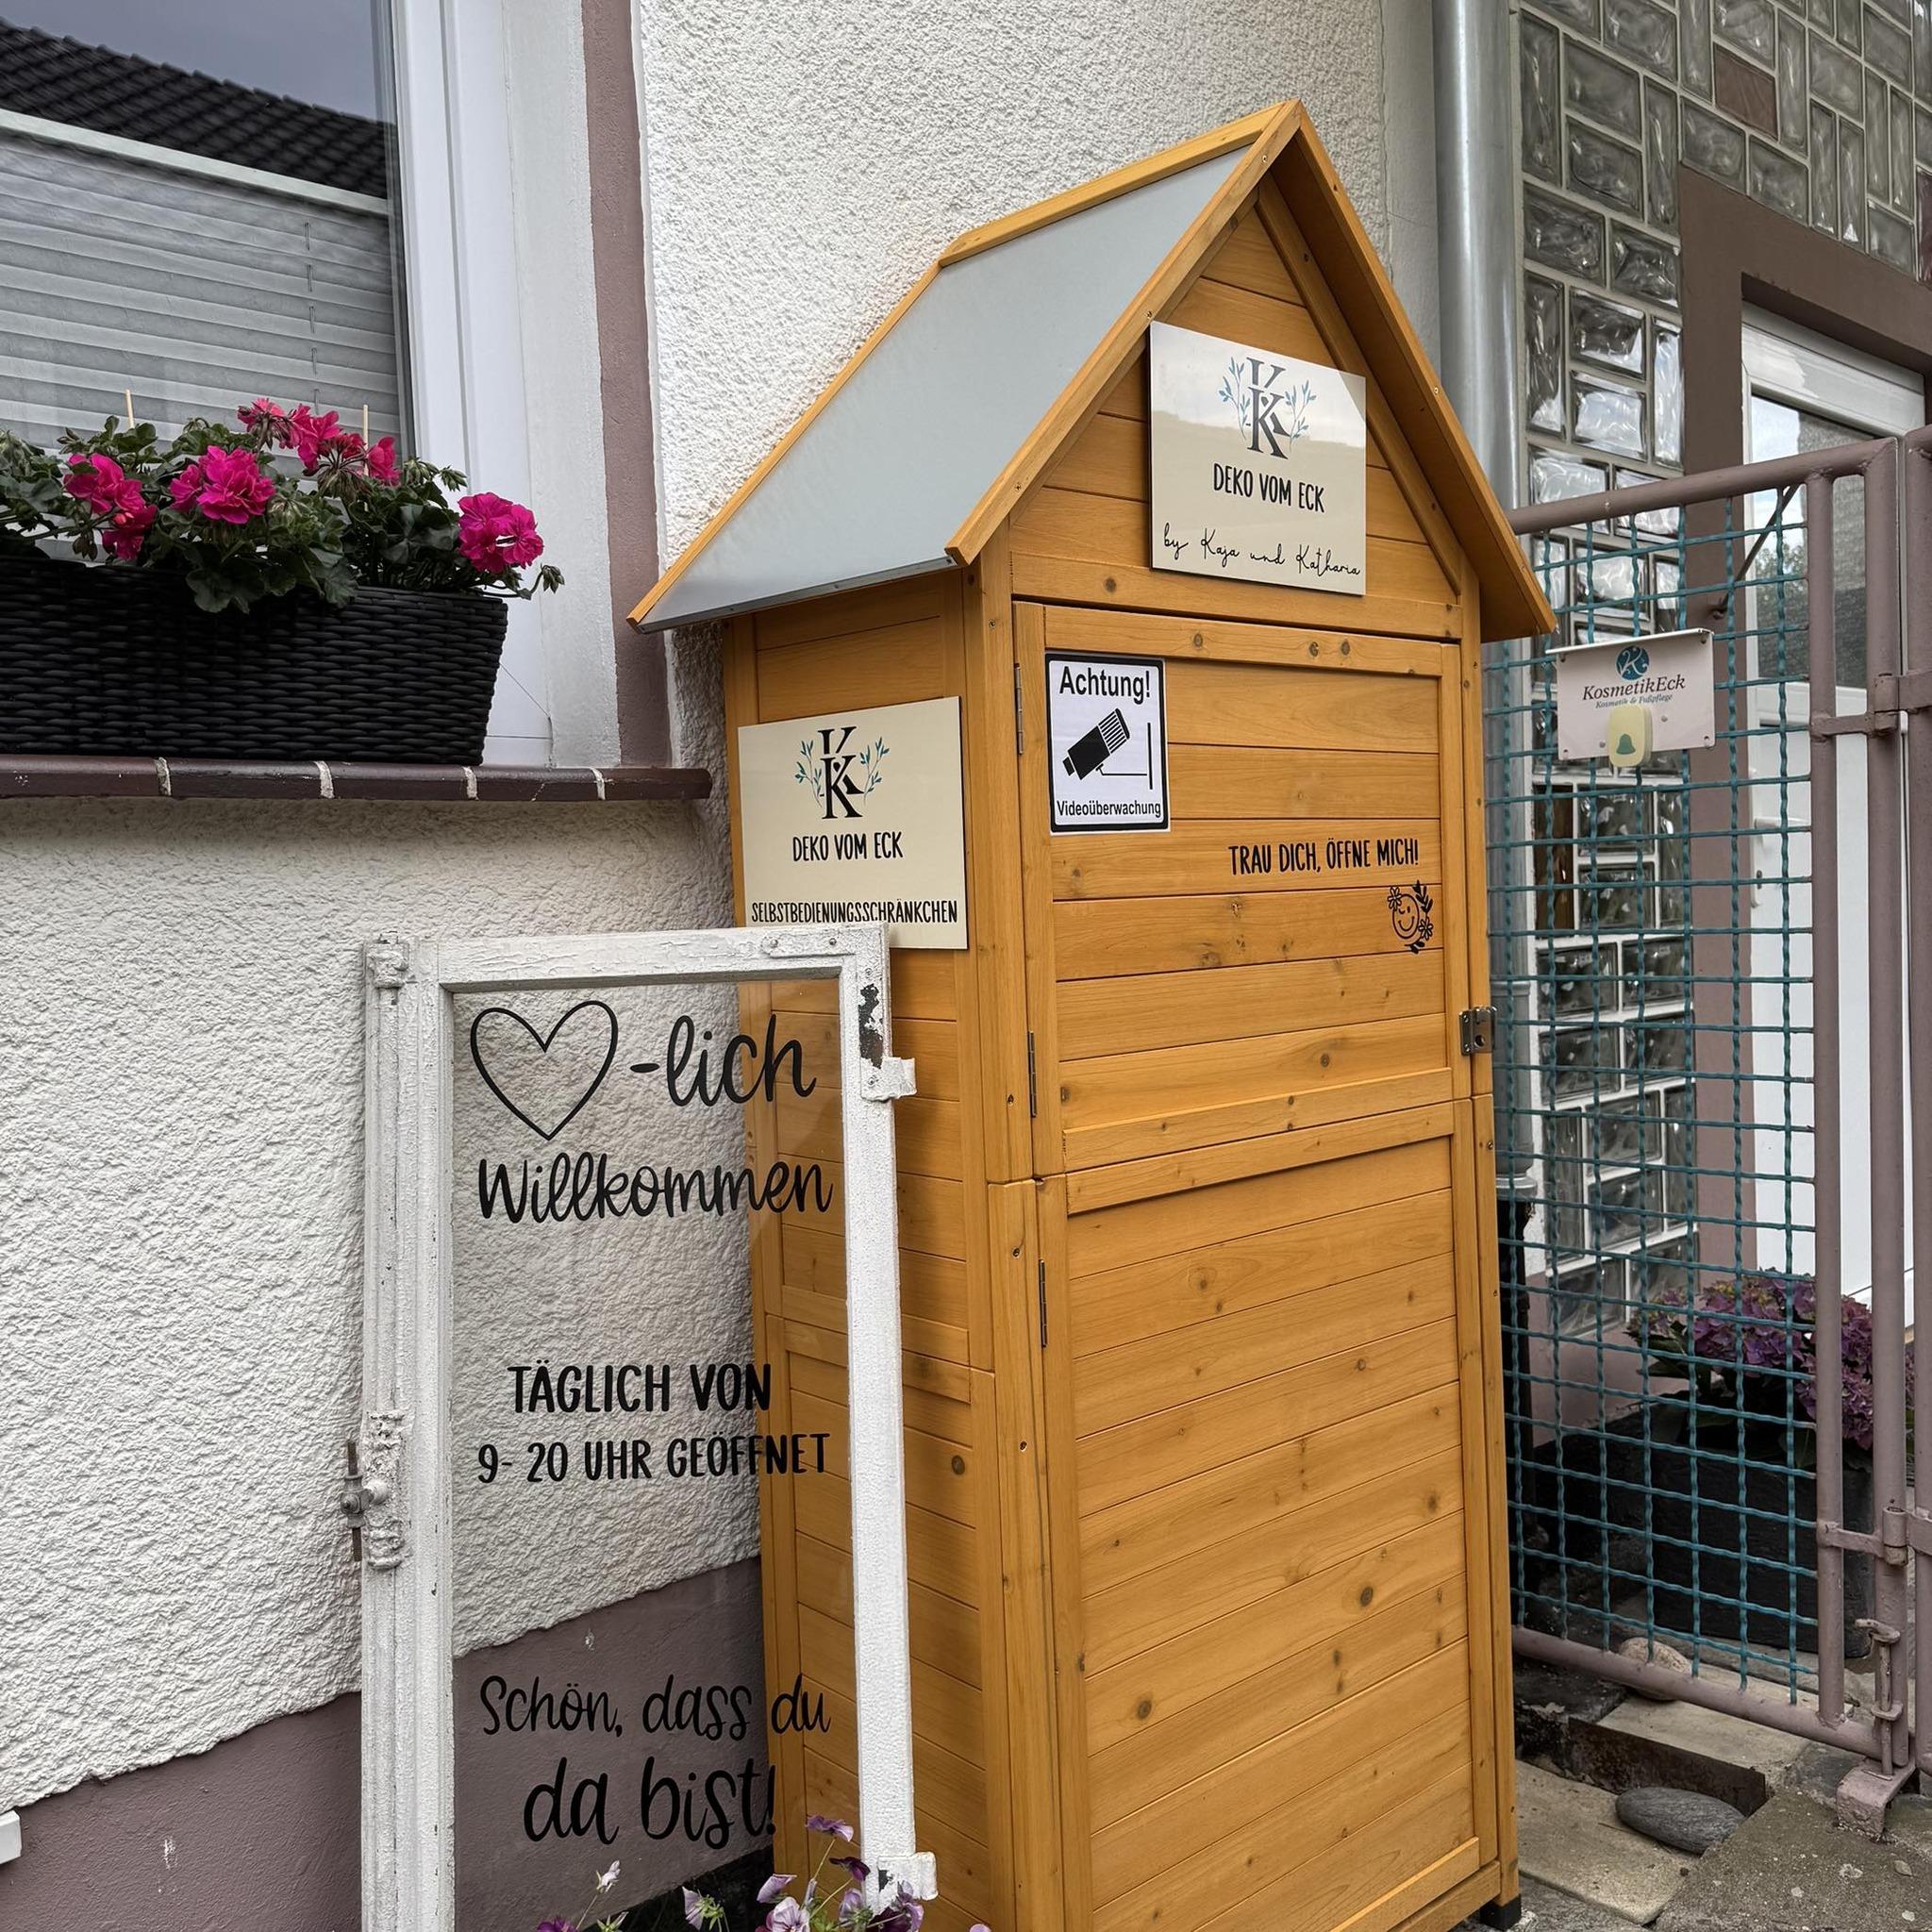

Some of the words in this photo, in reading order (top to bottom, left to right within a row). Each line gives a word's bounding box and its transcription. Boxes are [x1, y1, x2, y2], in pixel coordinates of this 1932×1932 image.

[1213, 462, 1253, 498] DEKO
[1258, 474, 1291, 506] VOM
[1298, 483, 1324, 513] ECK
[1164, 523, 1189, 559] by
[1200, 528, 1240, 566] Kaja
[1249, 543, 1285, 566] und
[1059, 666, 1150, 705] Achtung!
[1582, 674, 1686, 701] KosmetikEck
[1595, 698, 1627, 708] Kosmetik
[1057, 800, 1161, 818] Videoüberwachung
[792, 835, 828, 861] DEKO
[834, 833, 867, 860] VOM
[874, 831, 903, 858] ECK
[1228, 844, 1272, 875] TRAU
[1279, 842, 1321, 873] DICH,
[1326, 838, 1371, 869] ÖFFNE
[1377, 839, 1419, 866] MICH!
[751, 898, 958, 924] SELBSTBEDIENUNGSSCHRÄNKCHEN
[629, 1013, 817, 1107] -lich
[478, 1152, 834, 1224] Willkommen
[507, 1359, 670, 1413] TÄGLICH
[691, 1363, 772, 1412] VON
[526, 1441, 568, 1482] 20
[584, 1439, 652, 1481] UHR
[667, 1432, 831, 1478] GEÖFFNET
[480, 1674, 624, 1738] Schön,
[642, 1674, 753, 1741] dass
[772, 1674, 832, 1736] du
[523, 1757, 620, 1846] da
[641, 1756, 777, 1850] bist!
